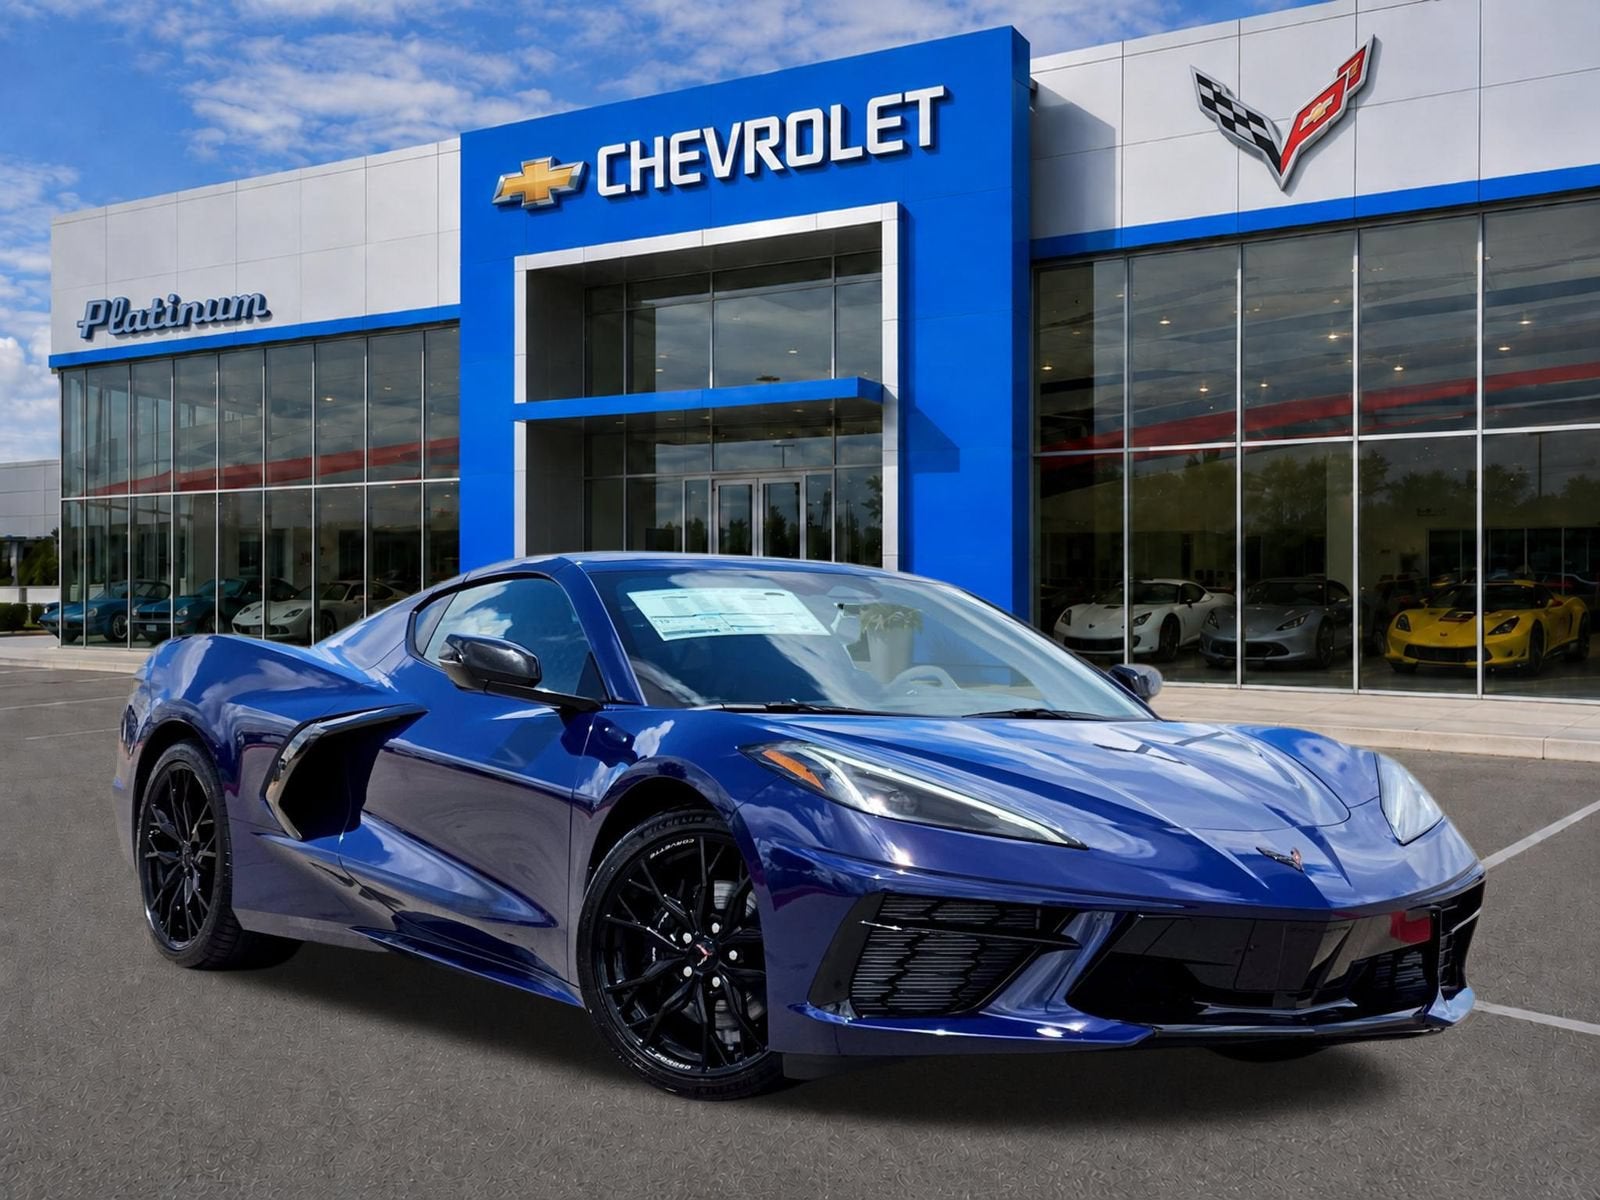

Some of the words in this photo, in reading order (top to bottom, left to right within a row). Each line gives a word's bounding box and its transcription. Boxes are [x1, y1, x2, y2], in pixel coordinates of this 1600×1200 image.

[596, 85, 946, 197] CHEVROLET
[77, 293, 271, 339] Platinum
[650, 838, 695, 859] CORVETTE
